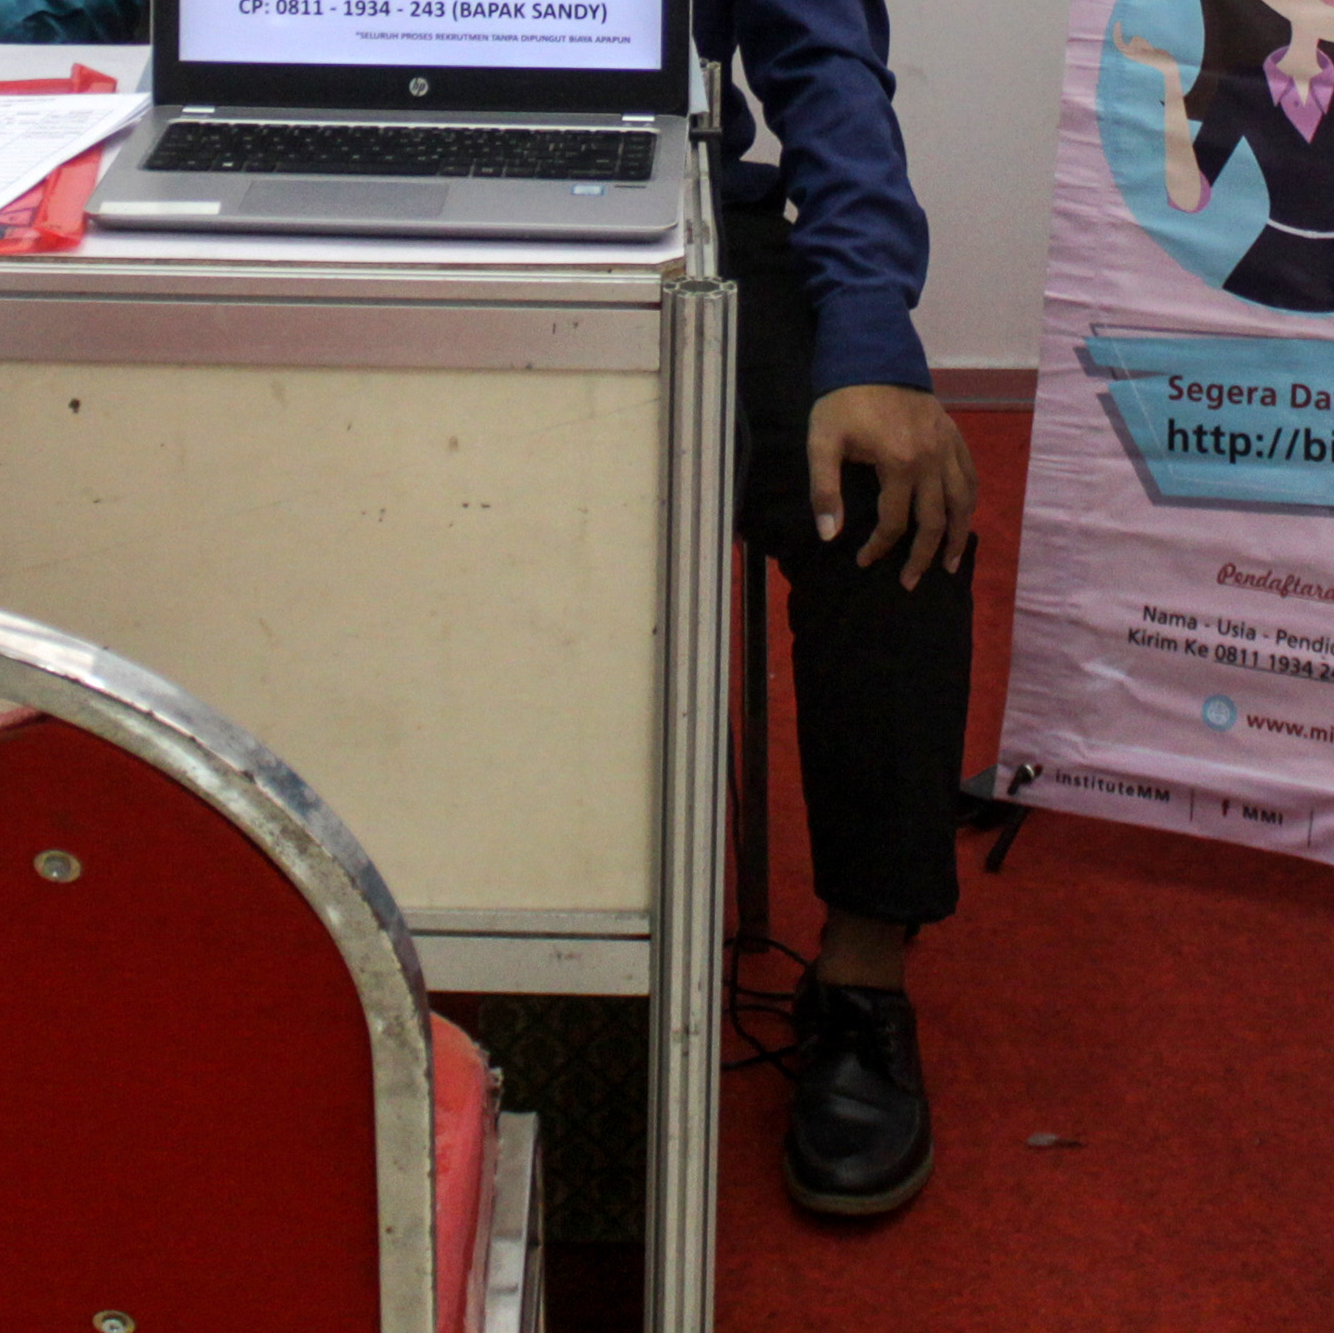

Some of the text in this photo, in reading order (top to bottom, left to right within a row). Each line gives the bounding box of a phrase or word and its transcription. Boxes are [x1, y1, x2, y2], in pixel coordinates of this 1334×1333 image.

[343, 0, 390, 17] 1934
[410, 1, 445, 18] 243
[452, 1, 525, 22] (BAPAK
[532, 2, 608, 24] SANDY)
[1168, 375, 1277, 409] Segera
[1143, 606, 1197, 630] Nama
[1217, 619, 1256, 641] Usia
[1128, 628, 1313, 677] Kirim 0811 1934
